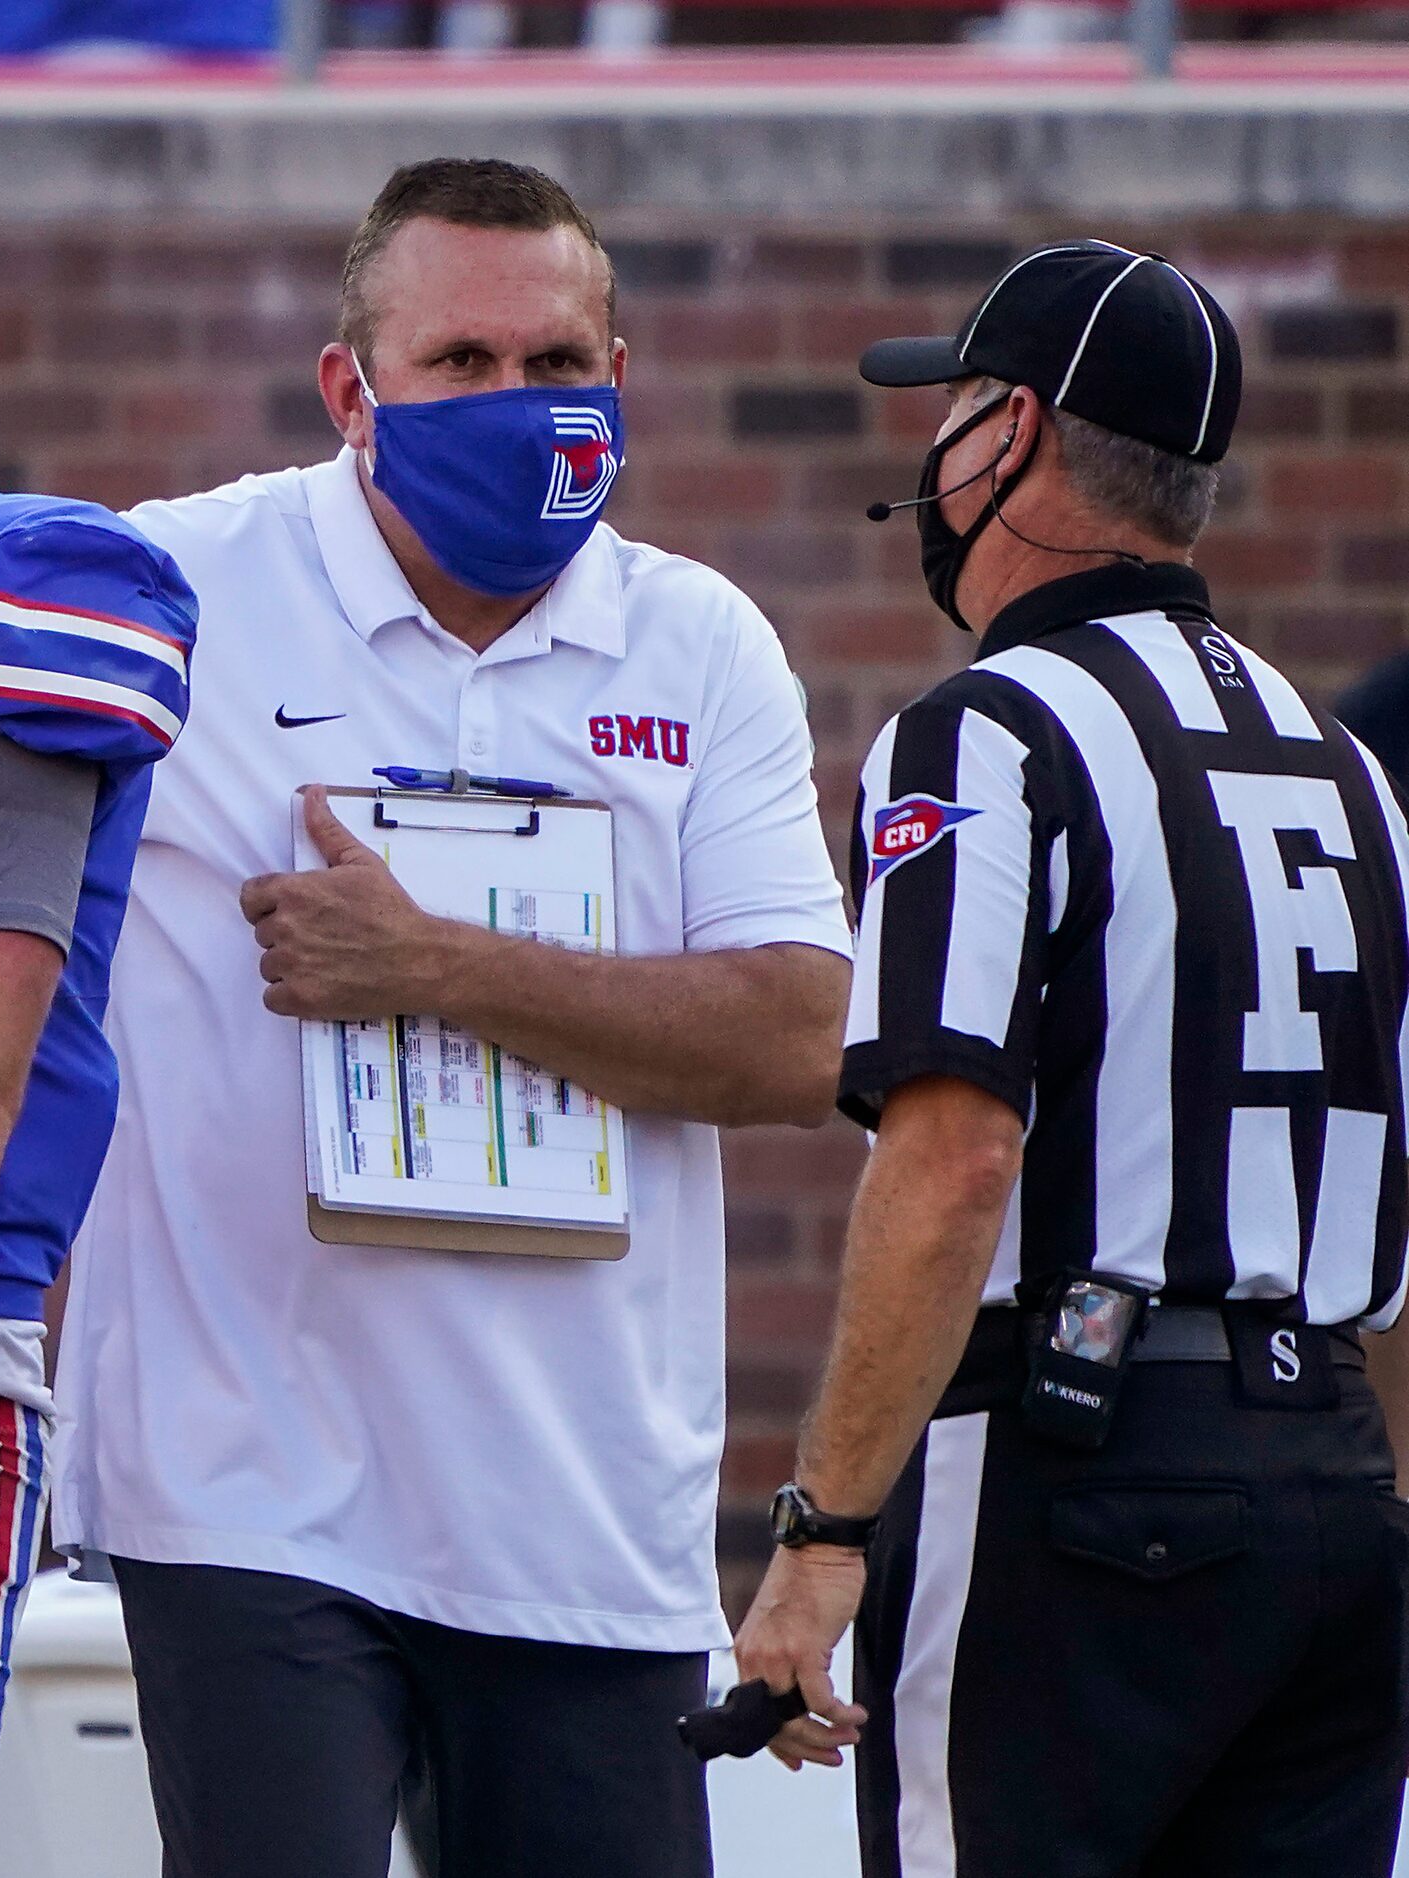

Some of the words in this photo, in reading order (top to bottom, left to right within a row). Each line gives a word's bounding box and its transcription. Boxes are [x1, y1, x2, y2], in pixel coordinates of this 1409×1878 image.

[1218, 675, 1245, 688] USA
[588, 714, 690, 768] SMU
[883, 821, 926, 849] CFO
[1206, 769, 1359, 1072] F
[1269, 1328, 1301, 1383] S
